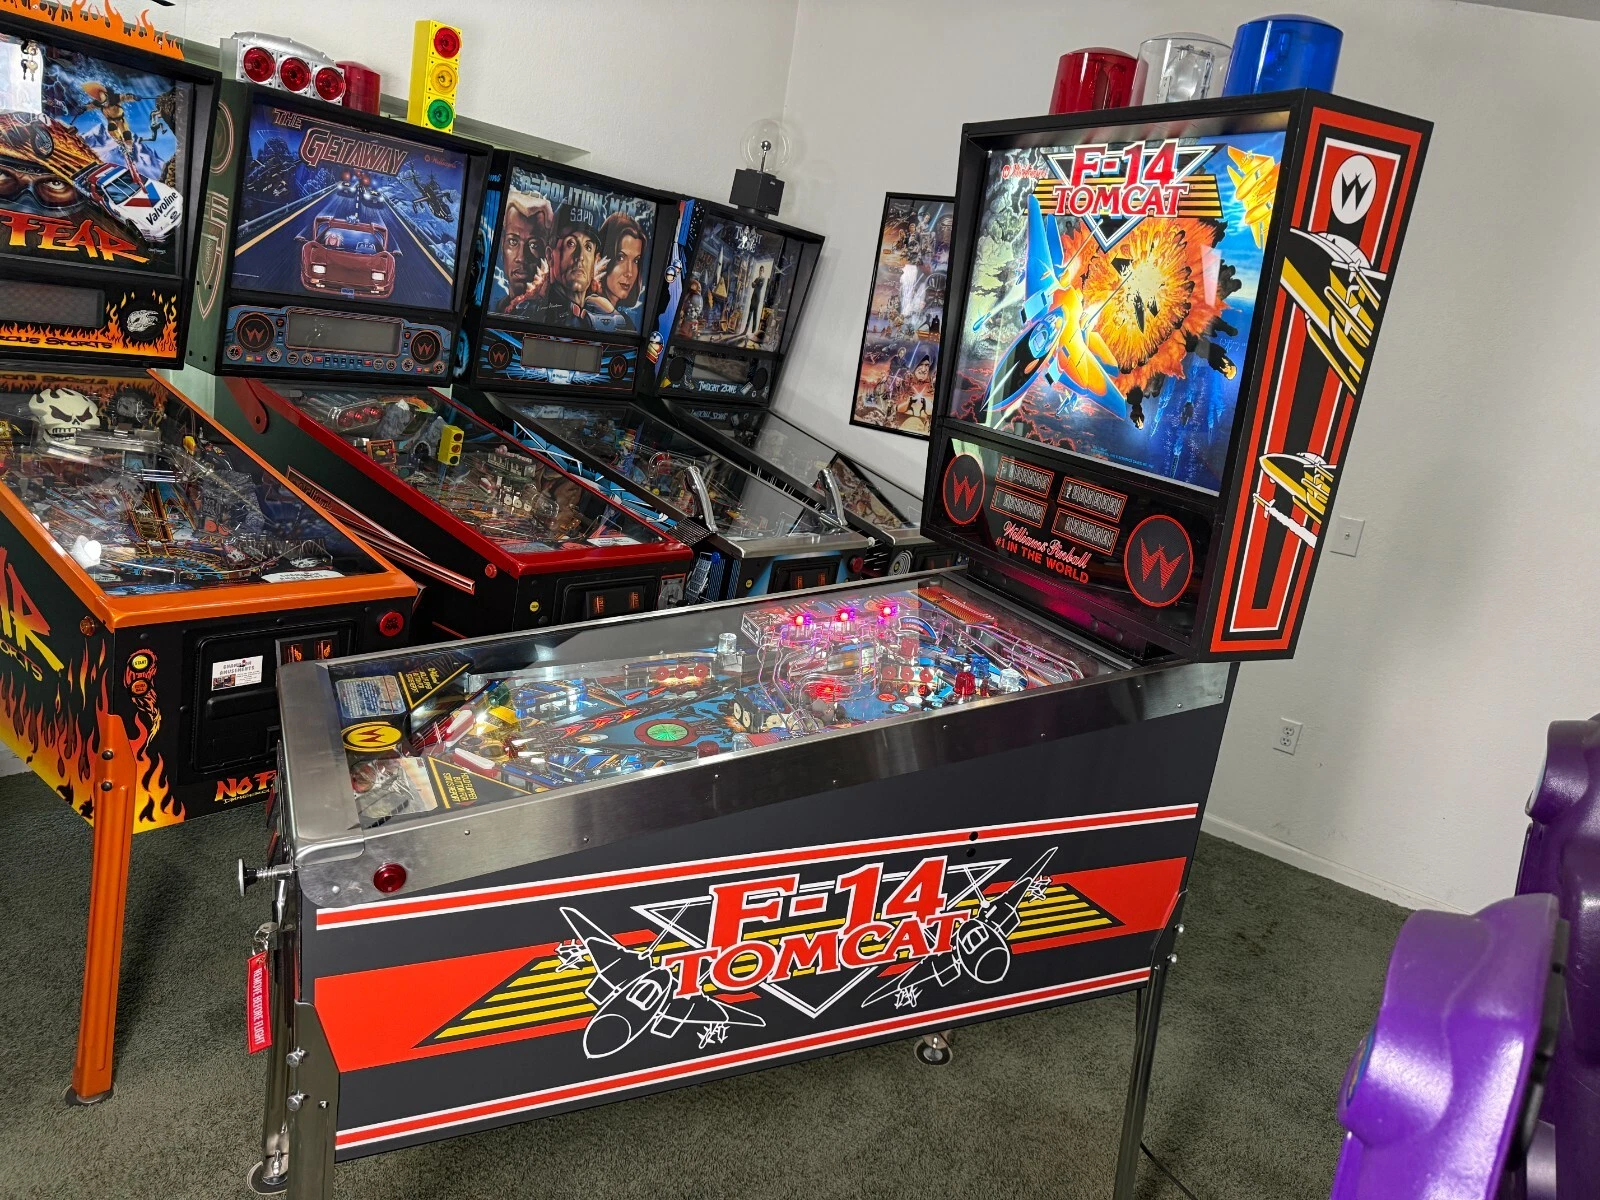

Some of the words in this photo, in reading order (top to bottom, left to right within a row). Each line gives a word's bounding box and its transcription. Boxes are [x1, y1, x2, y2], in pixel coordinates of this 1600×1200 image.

[273, 108, 302, 128] THE
[299, 127, 408, 176] GETAWAY
[1070, 137, 1180, 187] F-14
[145, 191, 179, 226] Valvoline
[520, 173, 603, 212] DEMOLITION
[1053, 183, 1190, 218] TOMCAT
[0, 208, 150, 264] FEAR
[45, 336, 113, 349] SPORTS
[720, 383, 738, 394] ZONE
[995, 536, 1007, 550] #1
[1007, 540, 1018, 554] IN
[1021, 545, 1043, 564] THE
[1046, 557, 1090, 584] WORLD
[1003, 520, 1049, 552] Williams
[1047, 539, 1093, 570] Pinball
[708, 855, 951, 951] F-14
[659, 909, 972, 999] TOMCAT
[252, 967, 263, 997] REMOVE
[252, 995, 264, 1022] BEFORE
[253, 1020, 266, 1045] FLIGHT
